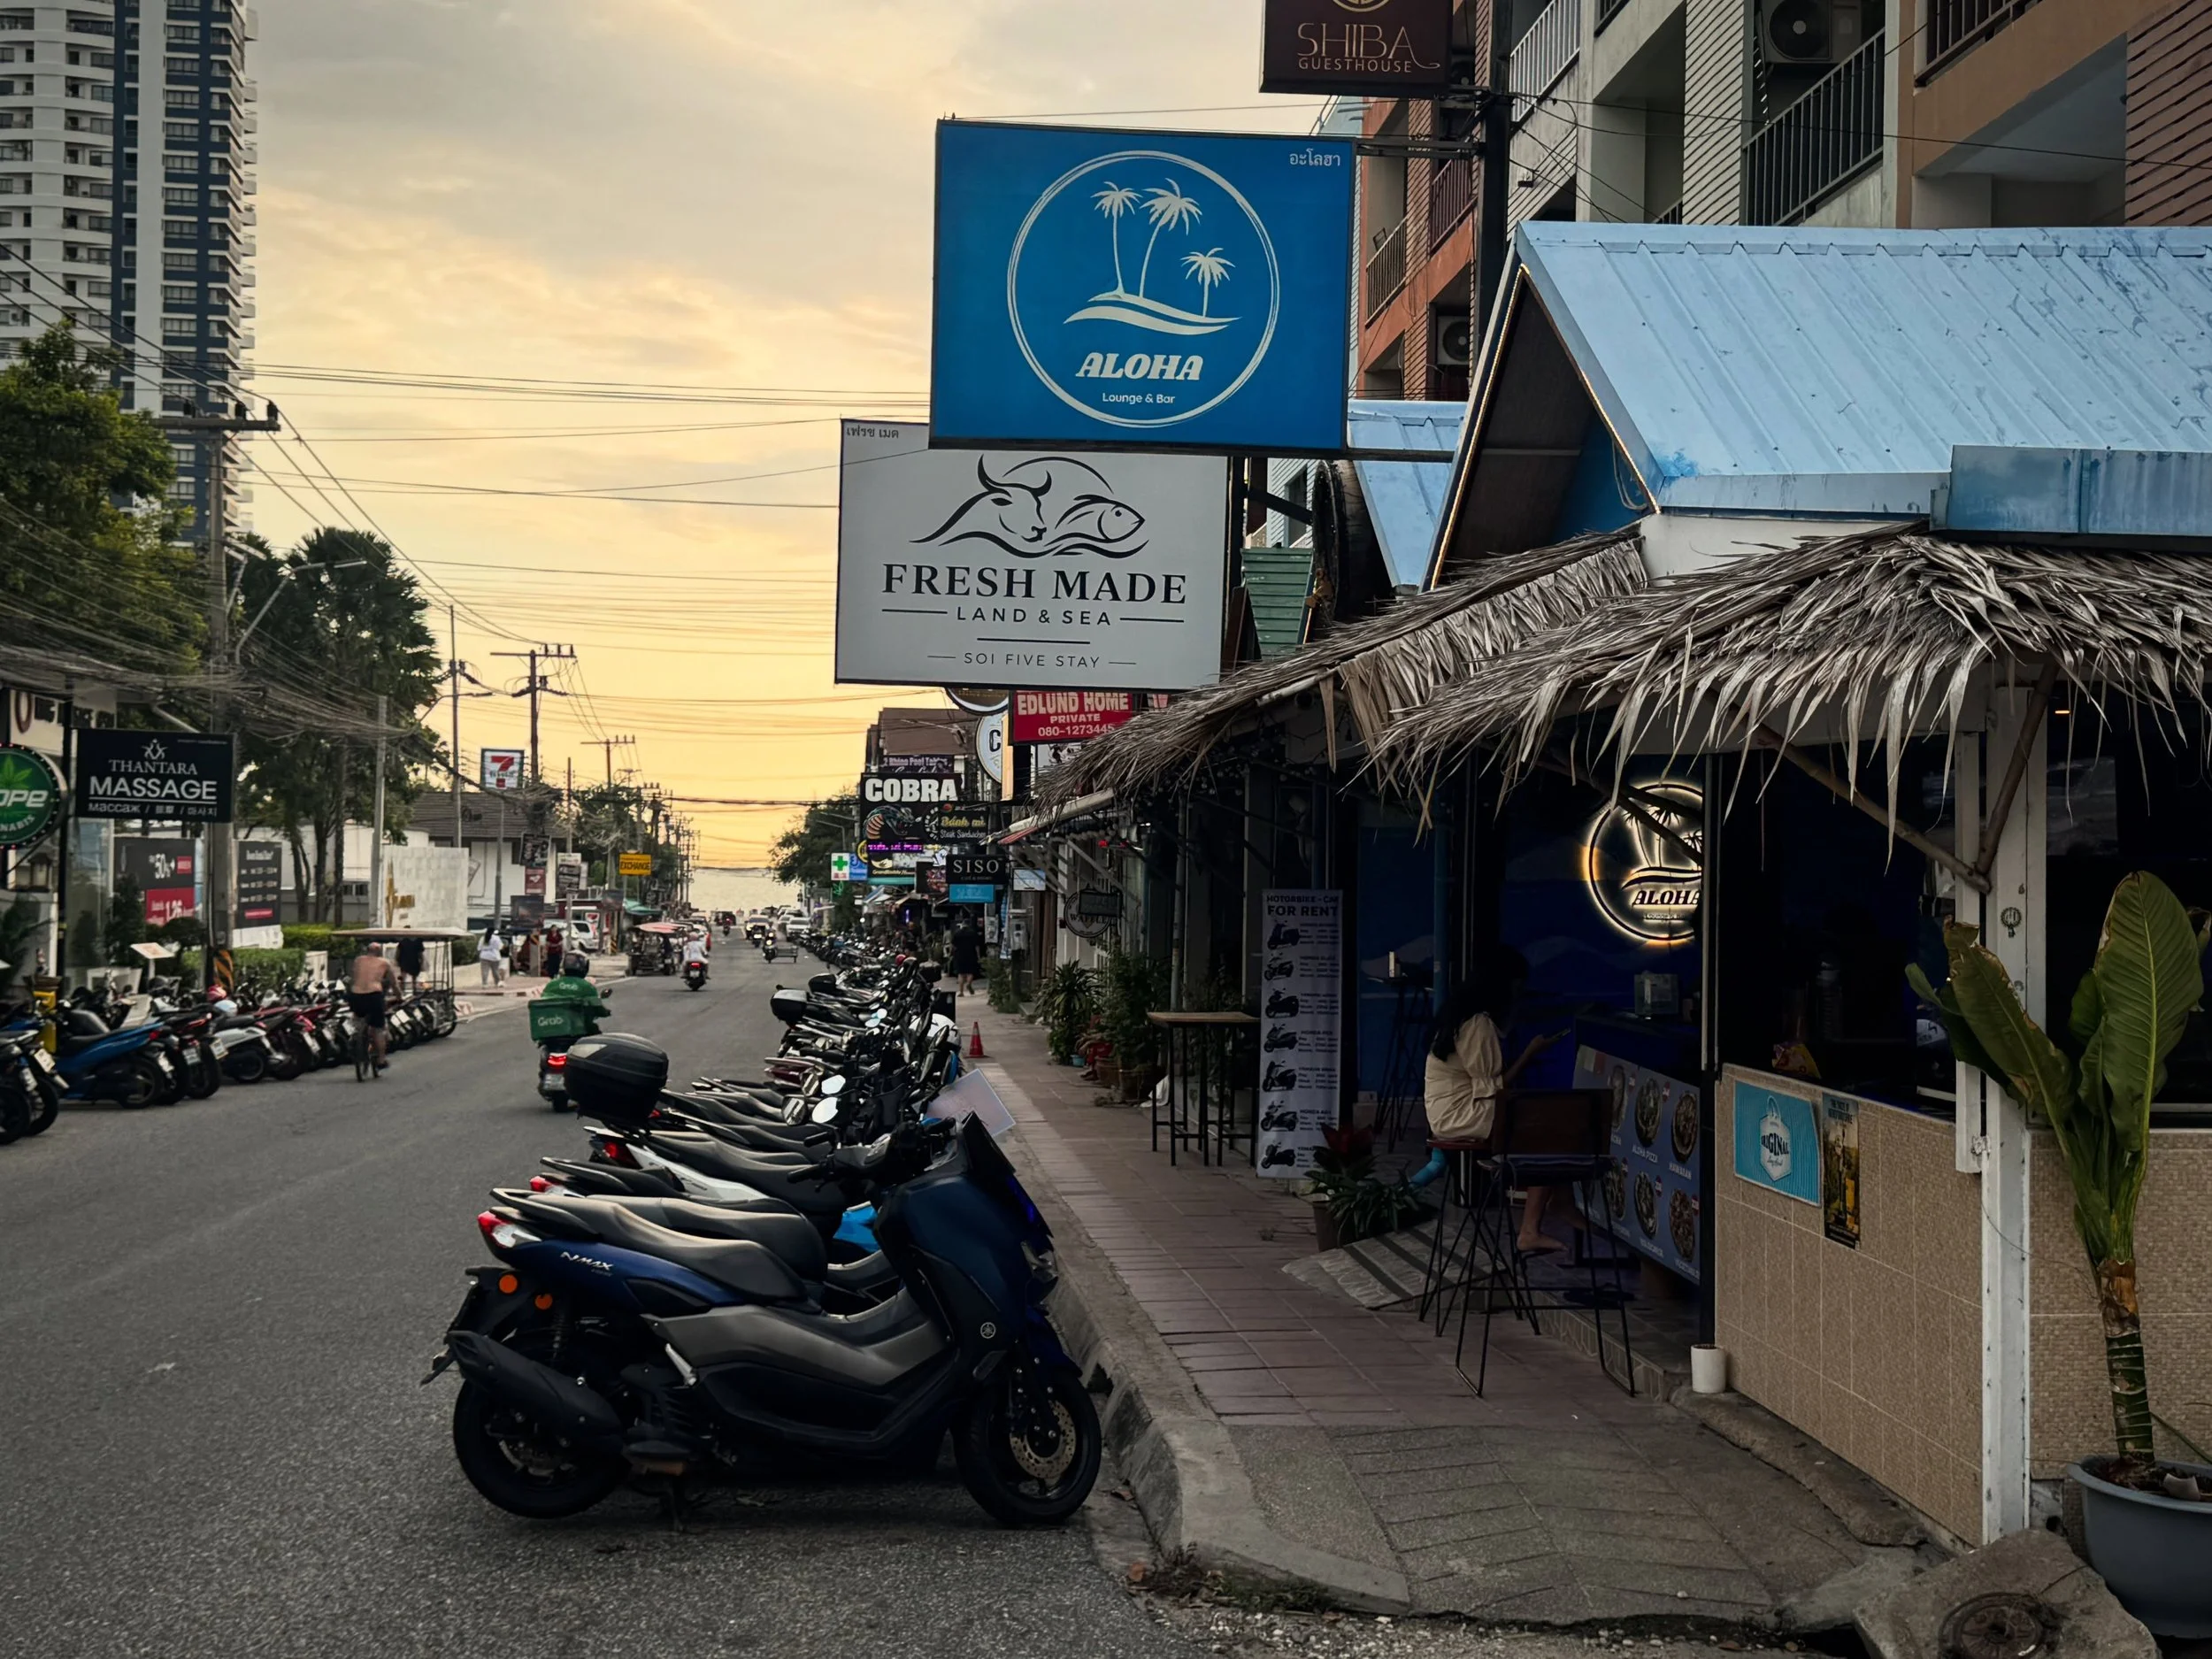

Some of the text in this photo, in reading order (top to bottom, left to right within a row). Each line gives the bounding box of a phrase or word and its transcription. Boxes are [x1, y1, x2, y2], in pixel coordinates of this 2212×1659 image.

[1297, 22, 1440, 69] SHIBA
[1298, 58, 1412, 73] GUESTHOUSE
[1289, 148, 1340, 166] อะโลฮา
[1075, 351, 1204, 381] ALOHA
[1102, 392, 1175, 405] Lounge & Bar
[882, 562, 1187, 605] FRESH MADE
[957, 606, 1111, 626] LAND & SEA
[964, 652, 1101, 669] SOI FIVE STAY
[1017, 692, 1129, 715] EDLUND HOME
[1050, 713, 1101, 724] PRIVATE
[1038, 724, 1115, 737] 080-1273445
[108, 759, 198, 775] THANTARA
[88, 775, 218, 800] MASSAGE
[864, 778, 959, 803] COBRA
[187, 806, 218, 818] 마사지
[953, 859, 1000, 873] SISO
[1267, 906, 1338, 917] FOR RENT
[537, 1015, 565, 1027] Grab
